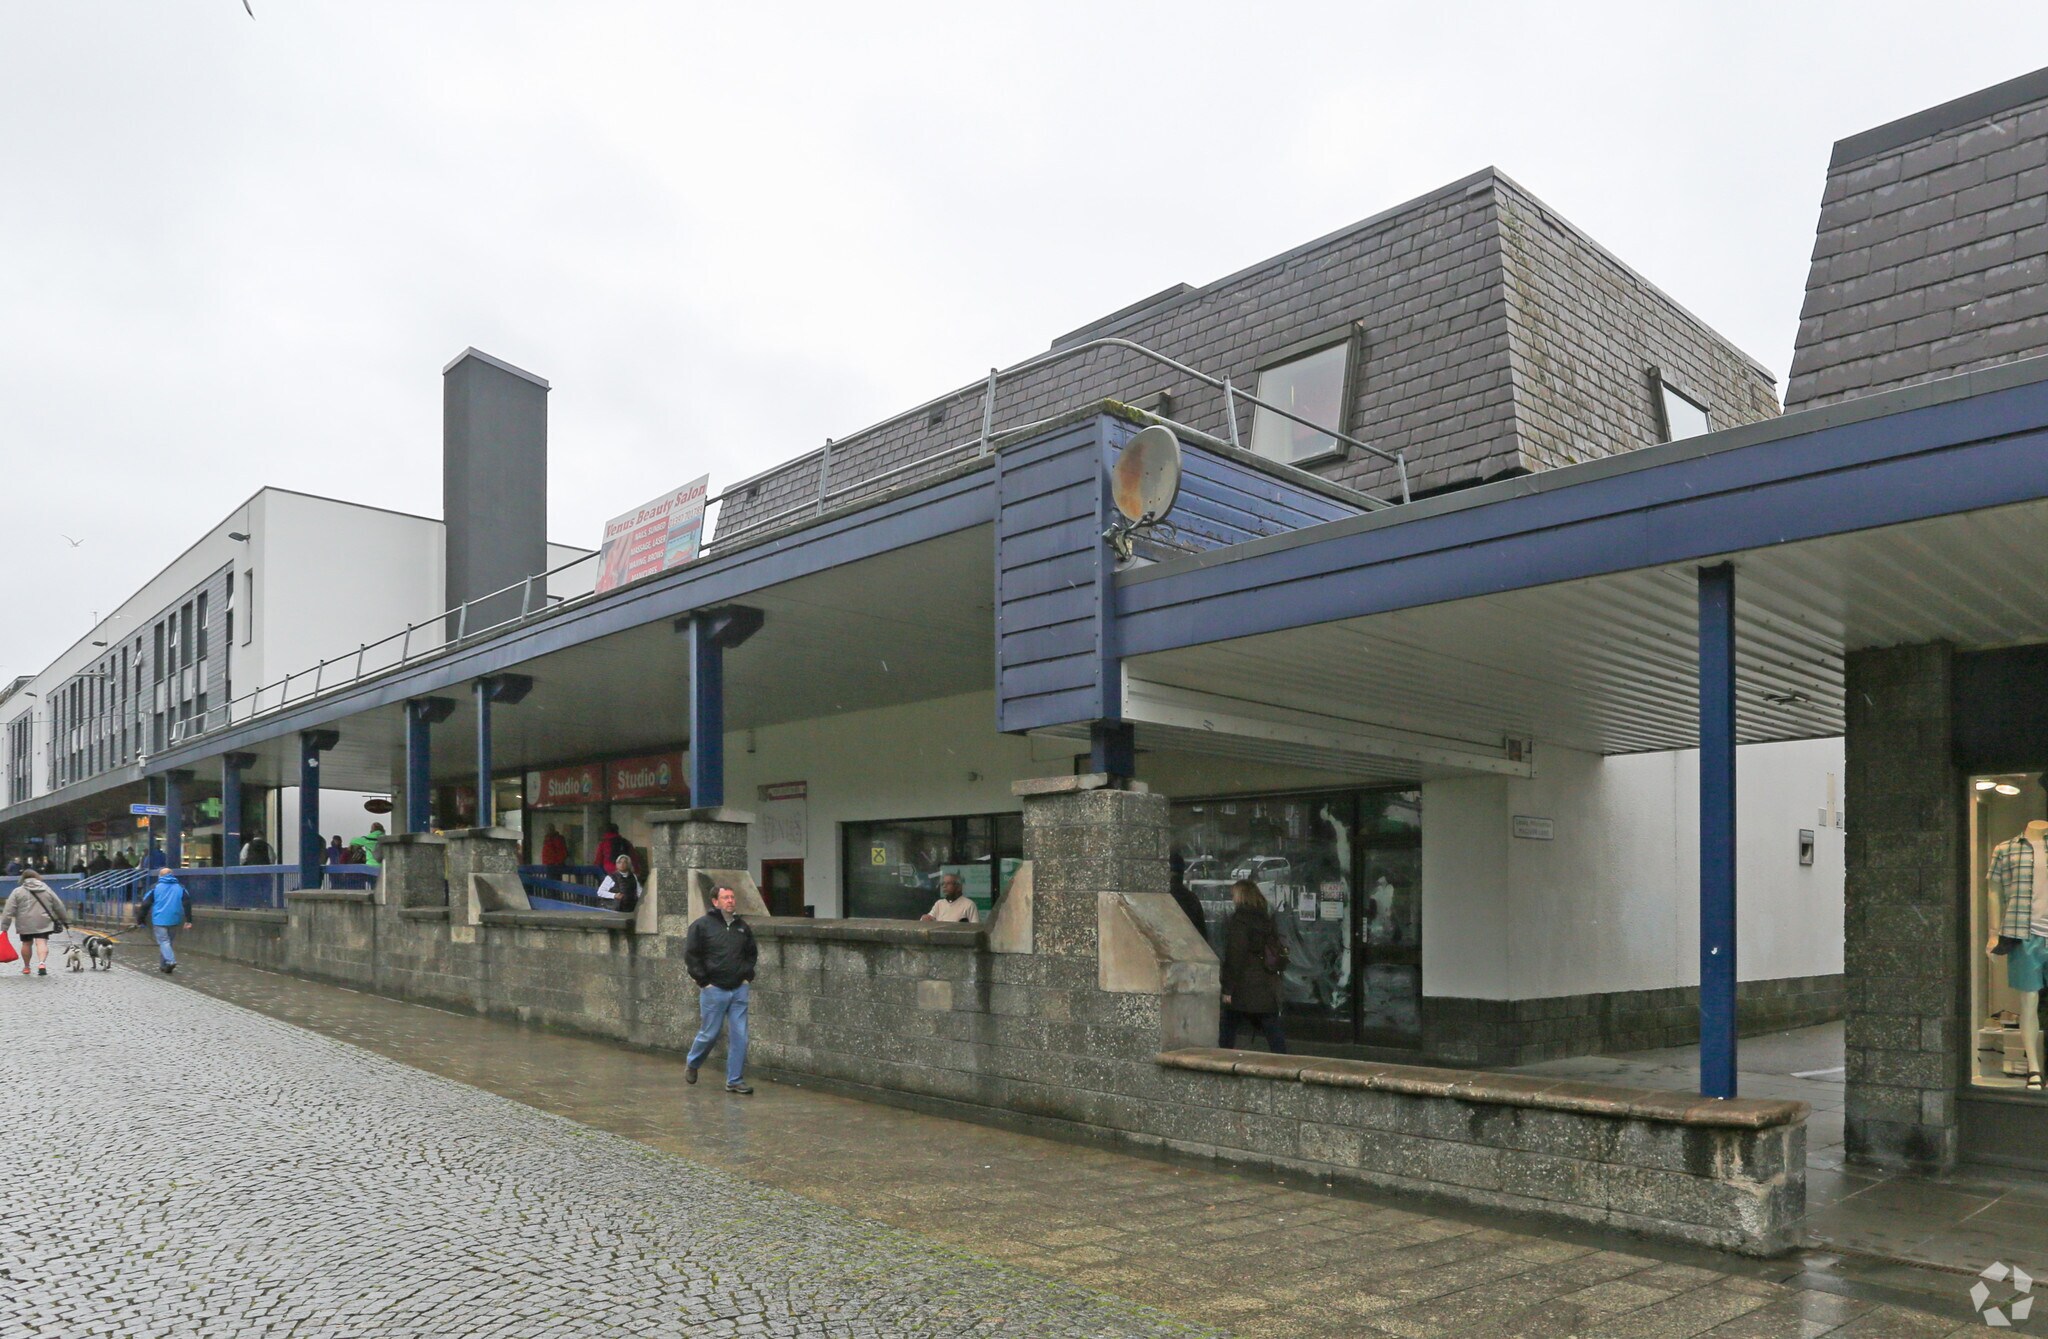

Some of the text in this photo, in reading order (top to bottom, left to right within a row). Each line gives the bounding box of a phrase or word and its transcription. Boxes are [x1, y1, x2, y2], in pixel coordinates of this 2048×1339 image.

[606, 517, 635, 538] Venus
[636, 498, 674, 525] Beauty
[674, 483, 707, 508] Salon
[548, 773, 590, 797] Studio 2
[618, 763, 668, 790] Studio 2
